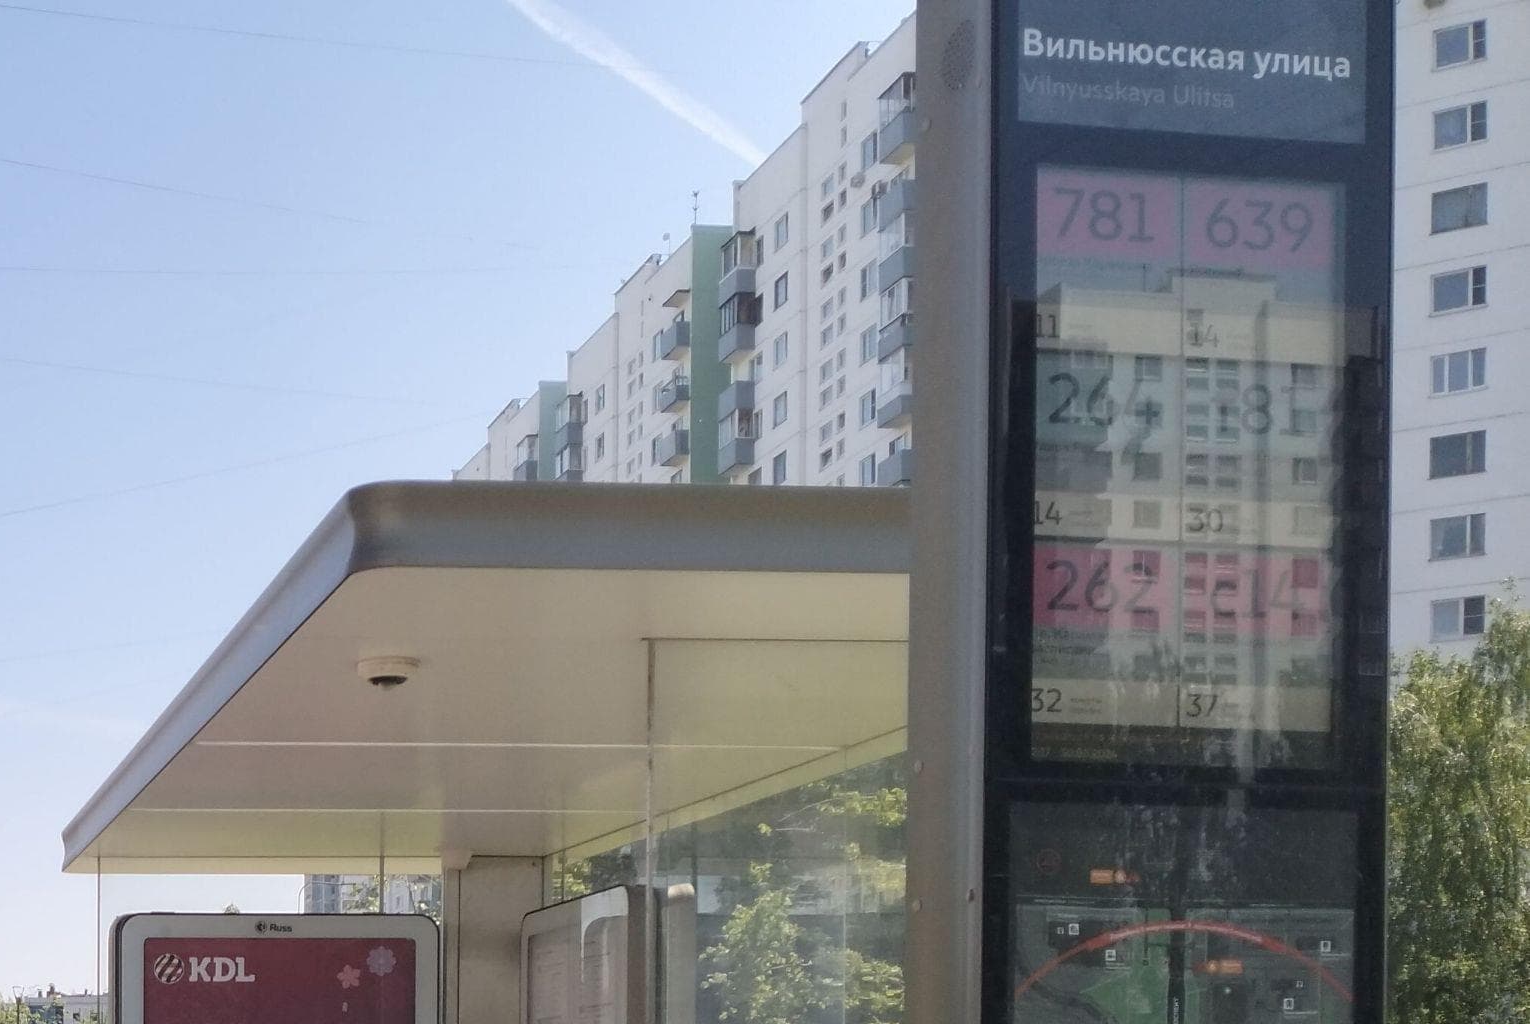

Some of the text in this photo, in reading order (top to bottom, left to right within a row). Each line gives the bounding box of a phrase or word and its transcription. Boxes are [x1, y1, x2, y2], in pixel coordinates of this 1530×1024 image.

[1023, 28, 1351, 81] Вильнюсская улица
[1022, 73, 1235, 109] Vilnyusskaya Ulitsa
[1052, 186, 1156, 243] 781
[1205, 197, 1315, 254] 639
[1188, 507, 1224, 533] 30
[1031, 687, 1063, 713] 32
[1186, 693, 1220, 718] 37
[188, 956, 256, 983] KDL
